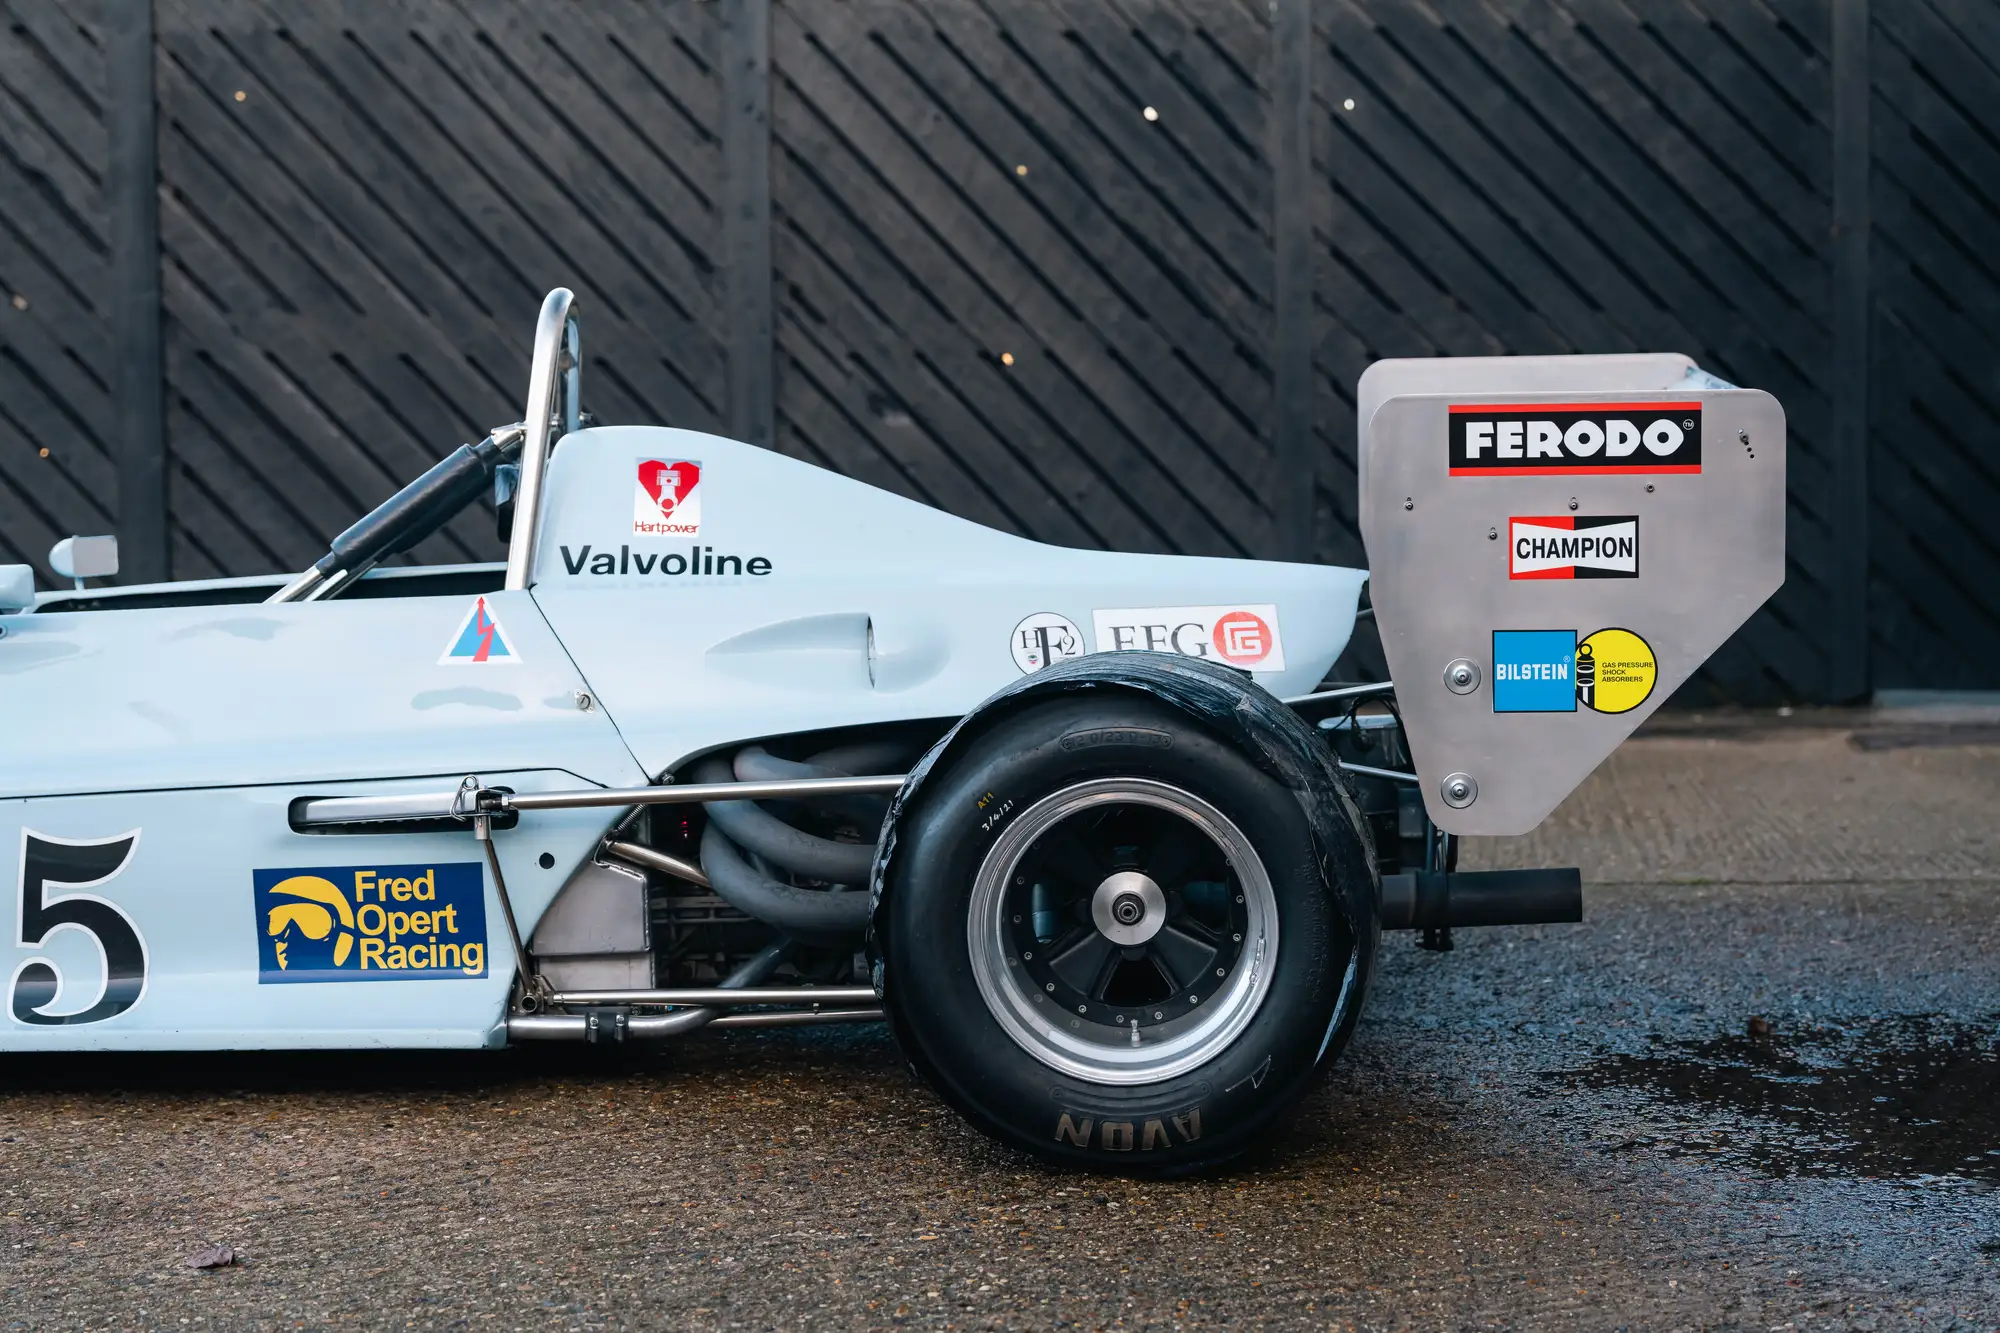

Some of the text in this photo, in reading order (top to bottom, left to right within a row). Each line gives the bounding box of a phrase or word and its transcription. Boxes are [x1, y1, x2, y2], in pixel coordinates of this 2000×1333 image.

[1466, 419, 1684, 459] FERODO
[559, 545, 773, 576] Valvoline
[1516, 536, 1633, 559] CHAMPION
[1496, 663, 1568, 680] BILSTEIN
[354, 869, 436, 902] Fred
[8, 826, 149, 1025] 5
[356, 903, 459, 943] Opert
[359, 936, 484, 976] Racing
[1054, 1106, 1202, 1151] AVON
